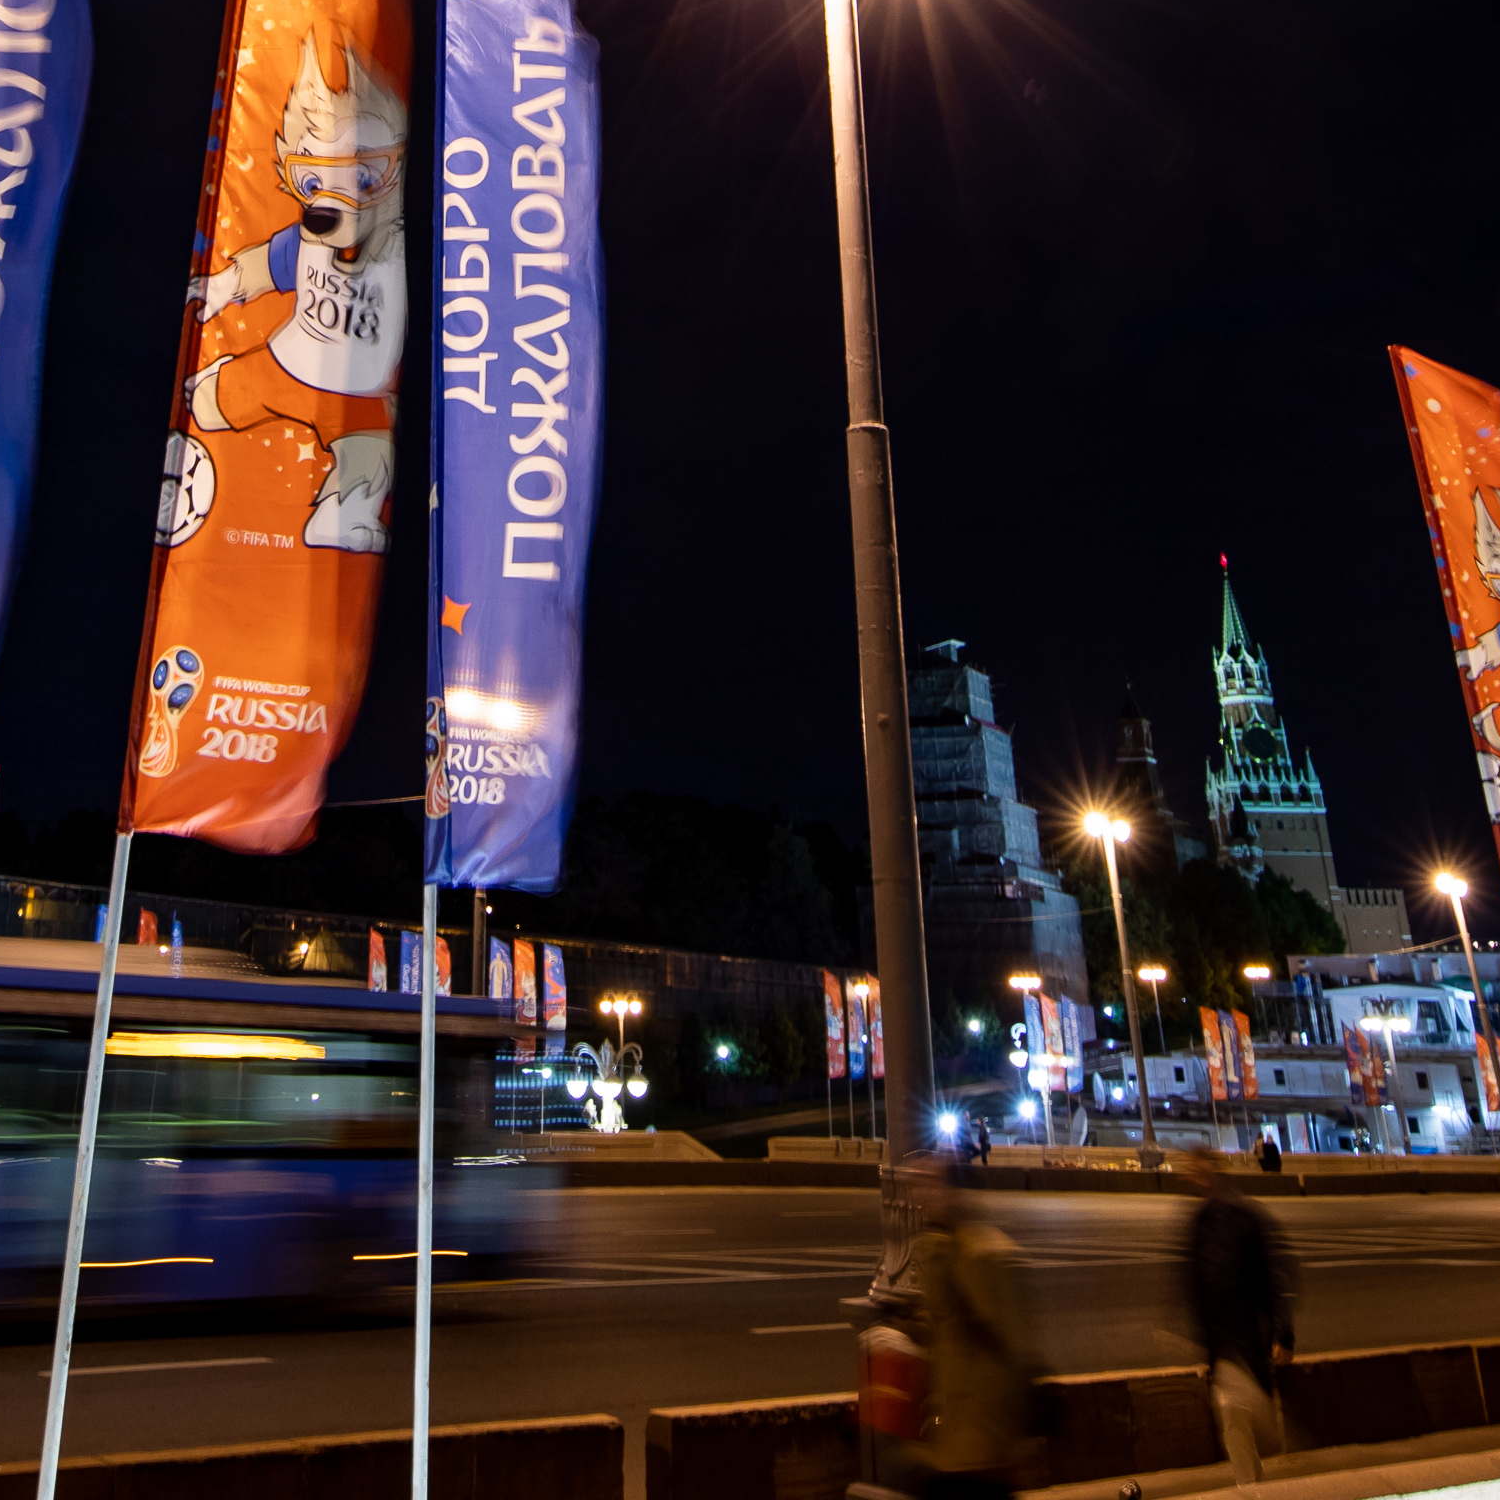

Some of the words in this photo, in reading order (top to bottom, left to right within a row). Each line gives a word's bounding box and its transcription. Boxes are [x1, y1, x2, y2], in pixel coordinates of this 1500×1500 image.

[442, 136, 498, 414] ДОБРО
[304, 289, 380, 344] 2018
[501, 15, 572, 582] ПОЖАЛОВАТЬ
[214, 676, 242, 691] FIFA
[242, 680, 288, 695] WORLD
[288, 685, 311, 697] CUP
[206, 693, 328, 733] RUSSIA
[196, 727, 279, 763] 2018
[449, 775, 506, 805] 2018
